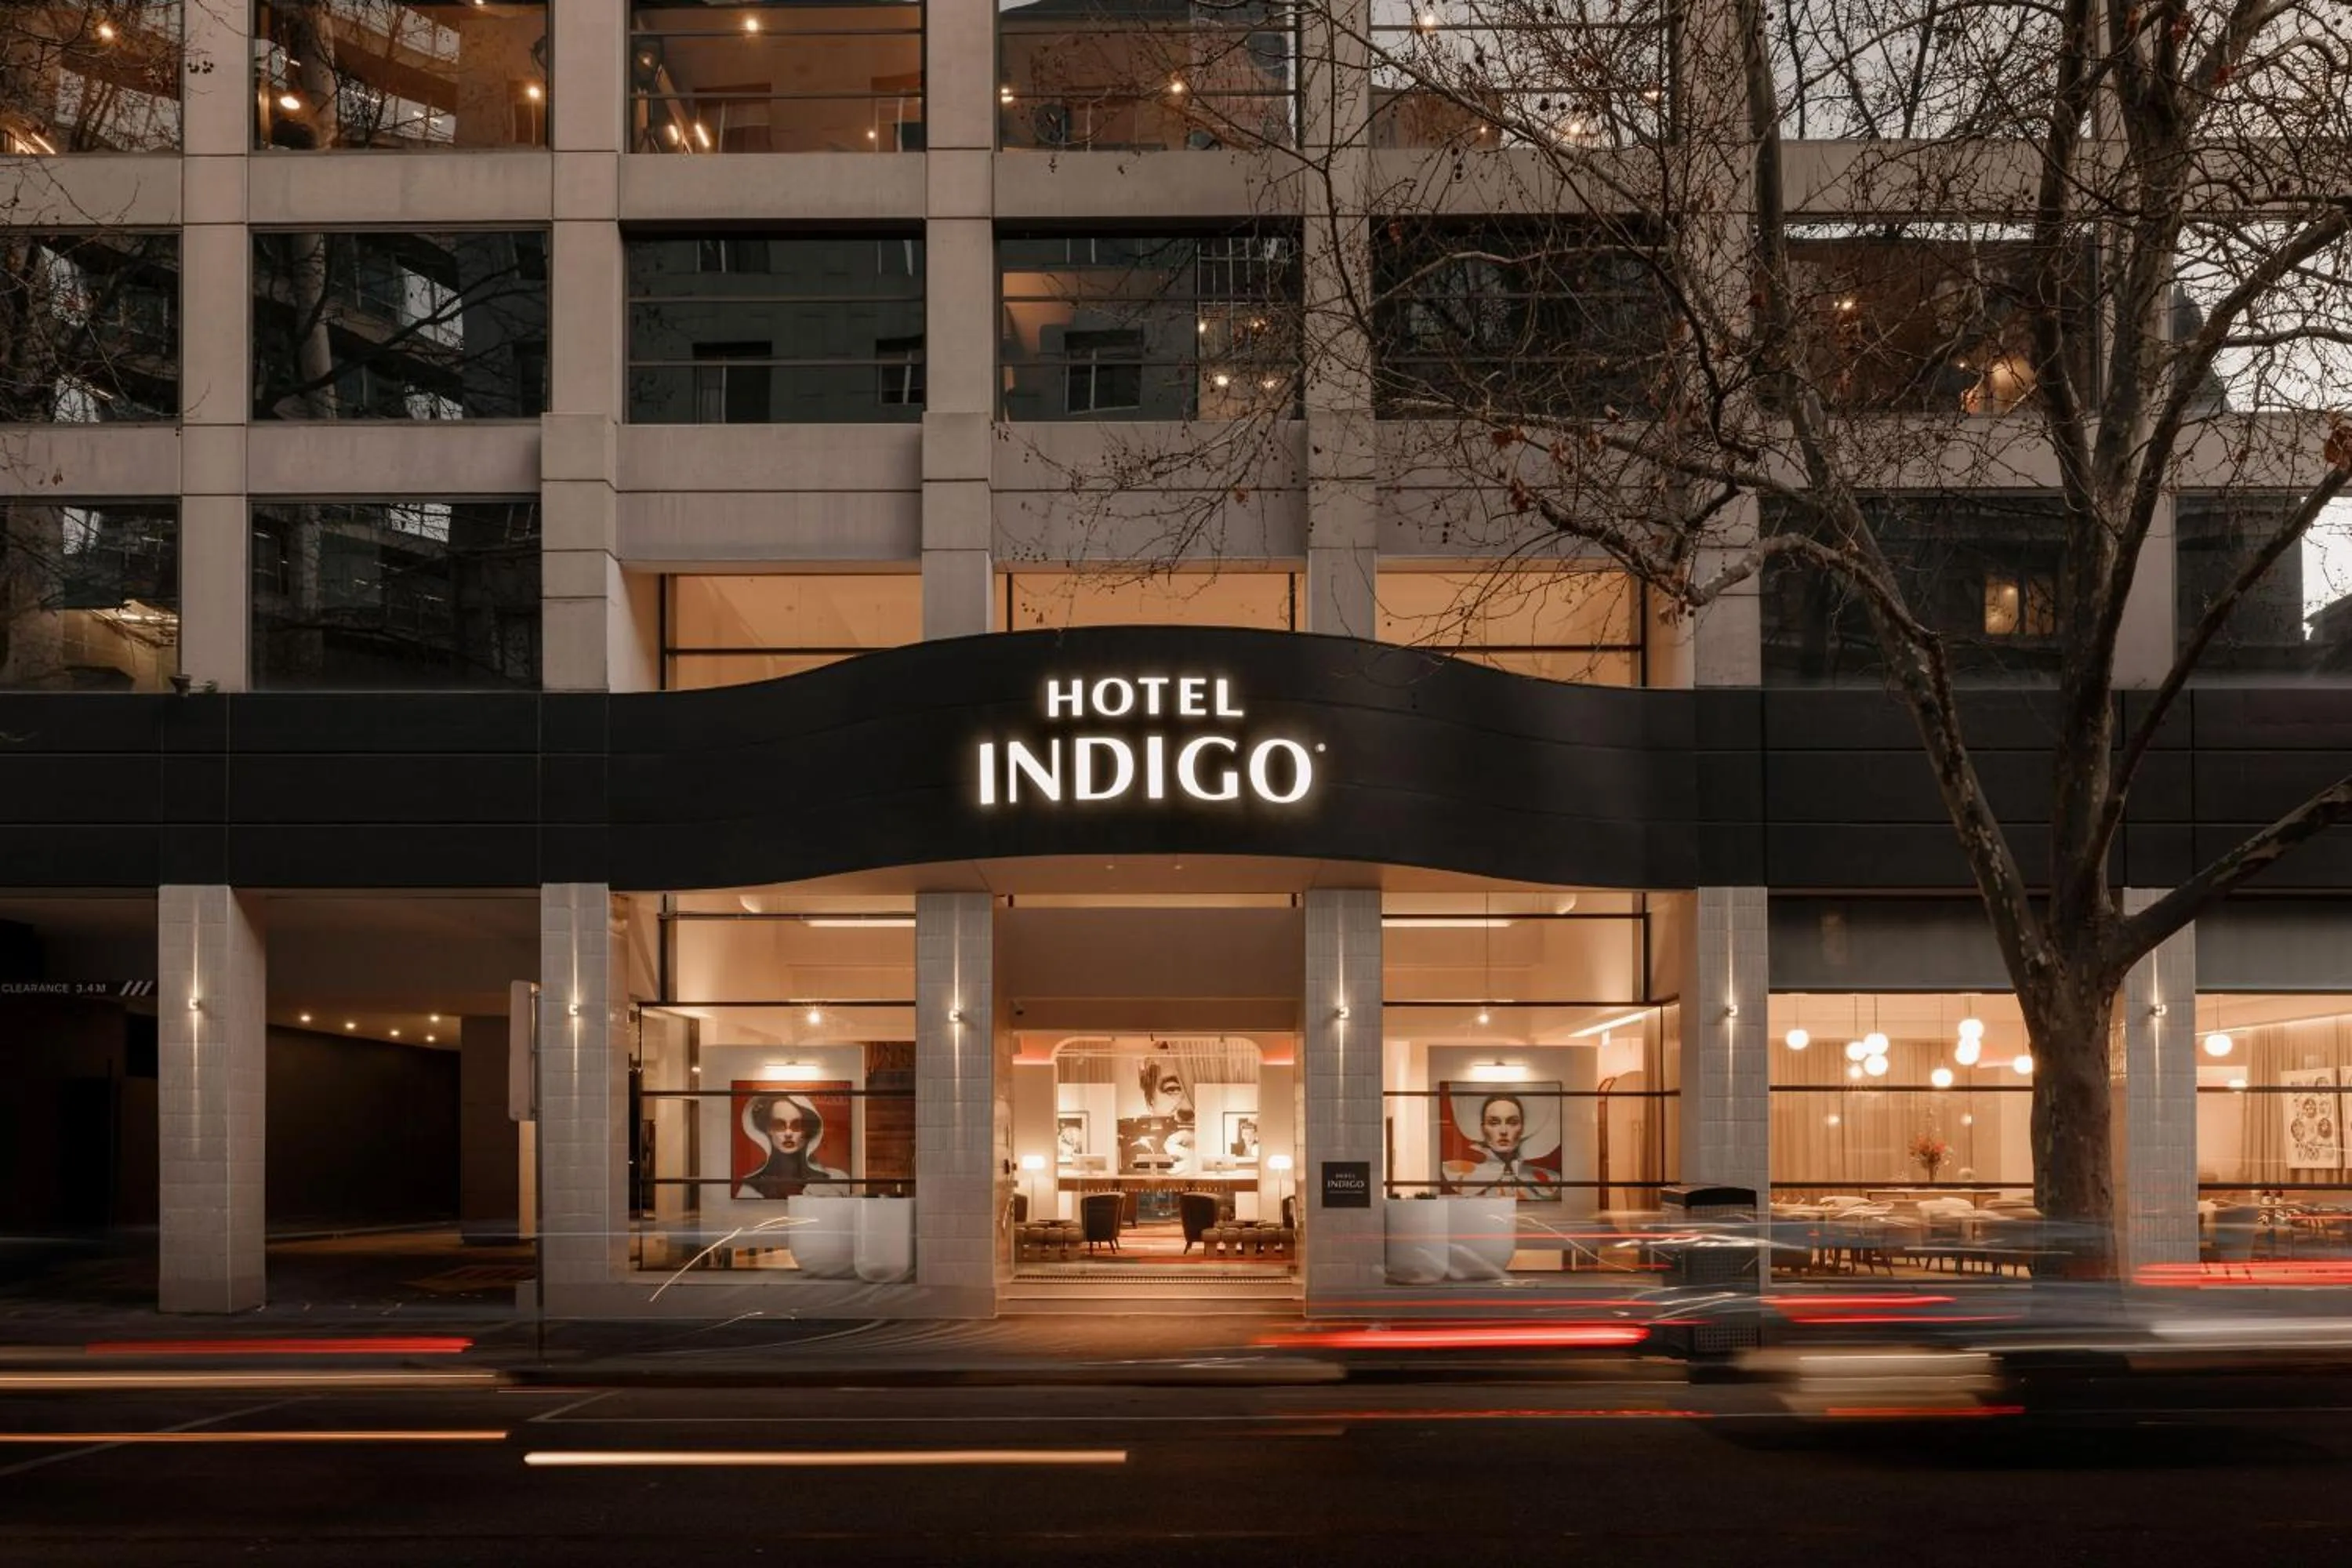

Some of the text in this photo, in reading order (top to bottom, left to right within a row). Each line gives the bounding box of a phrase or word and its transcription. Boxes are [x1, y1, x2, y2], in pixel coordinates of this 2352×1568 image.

[1048, 677, 1243, 717] HOTEL
[979, 736, 1314, 805] INDIGO
[1, 983, 70, 993] CLEARANCE
[1327, 1179, 1365, 1189] INDIGO
